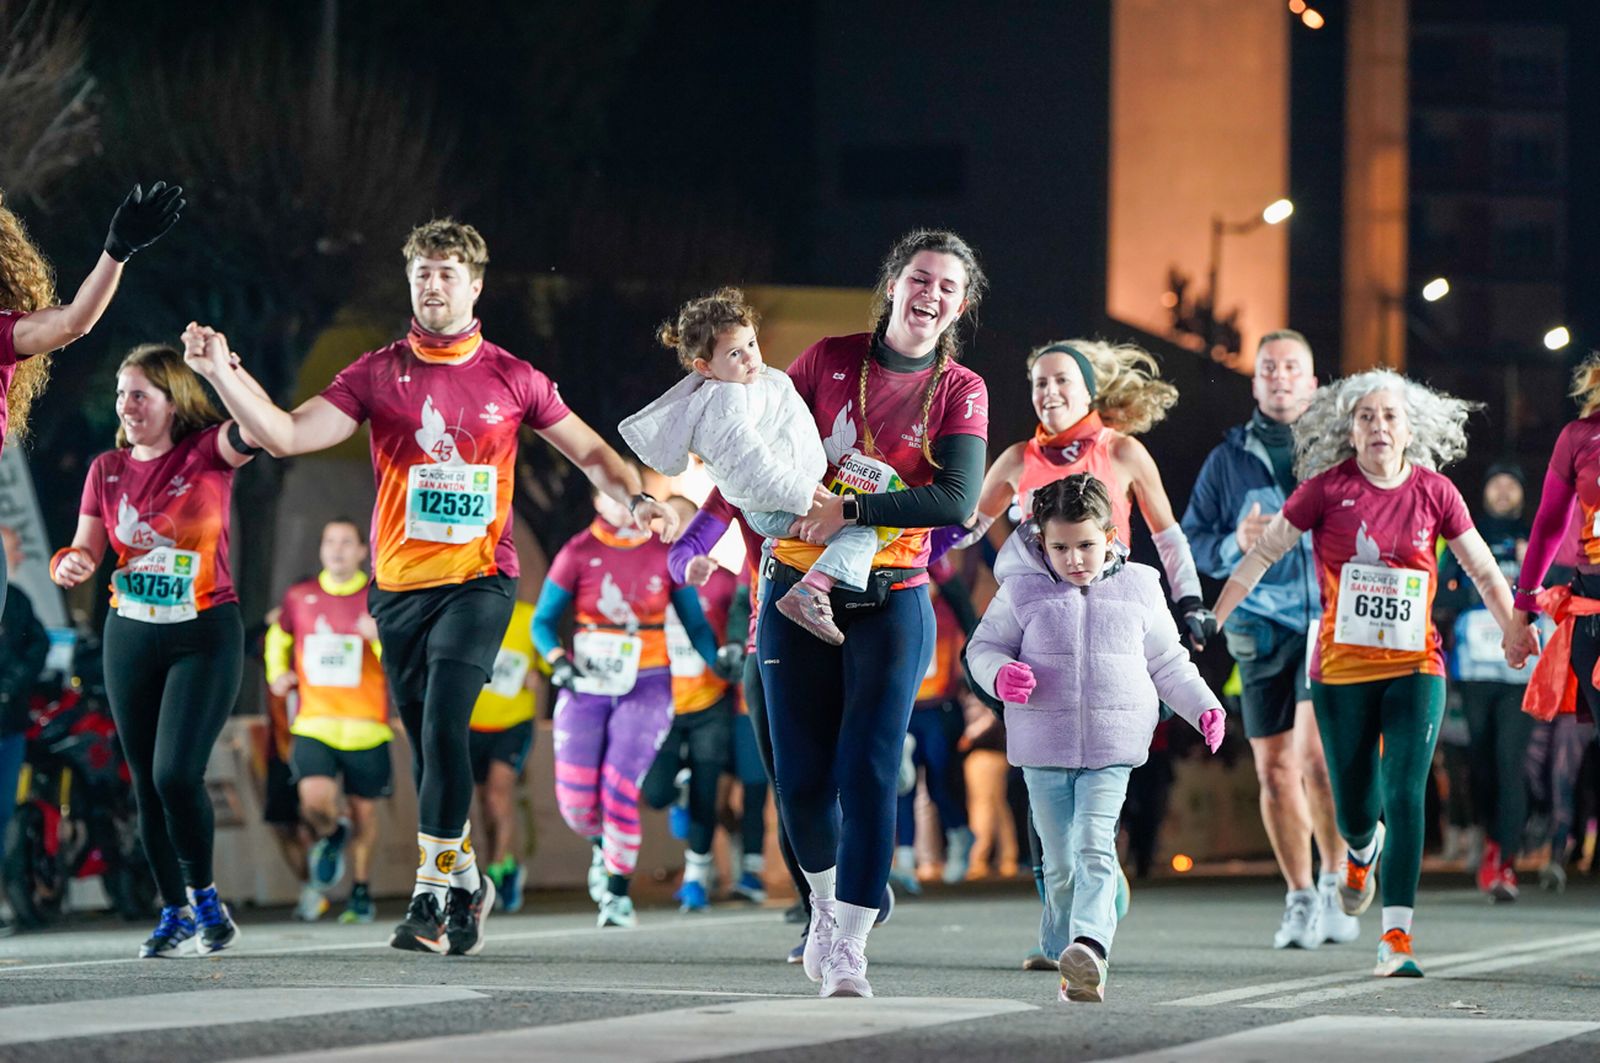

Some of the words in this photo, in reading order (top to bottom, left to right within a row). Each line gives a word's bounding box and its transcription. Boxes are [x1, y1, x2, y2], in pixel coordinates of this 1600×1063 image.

[431, 439, 454, 462] 43
[418, 480, 435, 489] SAN
[429, 472, 454, 480] NOCHE
[456, 473, 465, 482] DE
[845, 474, 879, 493] ANTÓN
[869, 471, 882, 482] DE
[418, 490, 484, 517] 12532
[132, 529, 154, 546] 43
[124, 573, 184, 599] 13754
[1351, 583, 1367, 592] SAN
[1369, 584, 1398, 595] ANTÓN
[1362, 576, 1387, 584] NOCHE
[1389, 577, 1398, 585] DE
[1355, 594, 1411, 621] 6353
